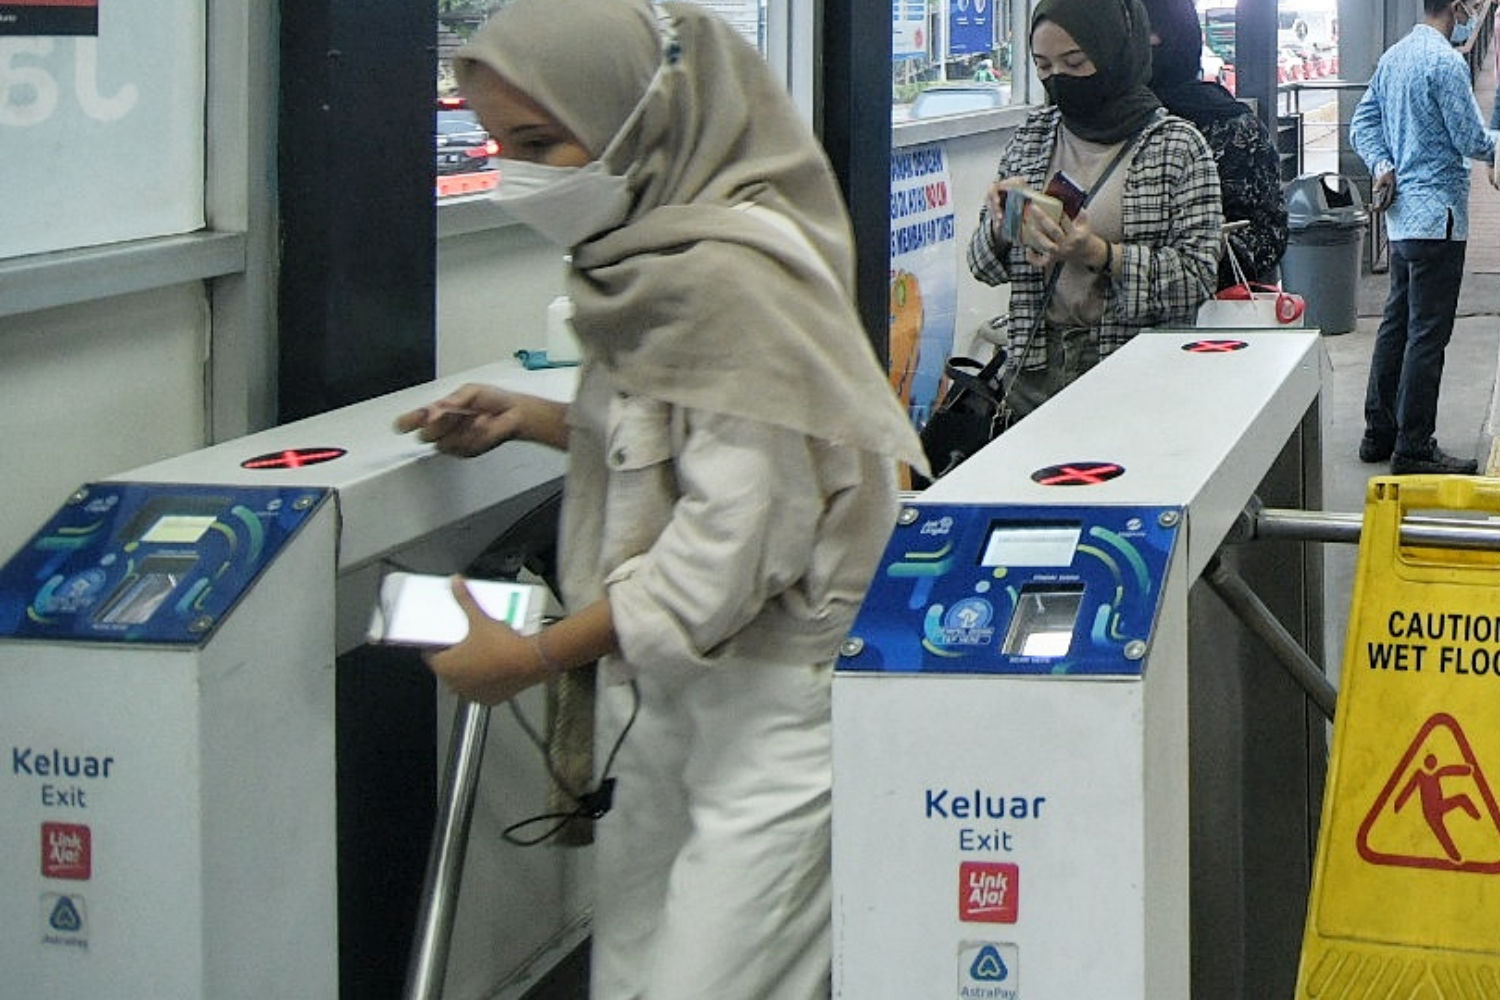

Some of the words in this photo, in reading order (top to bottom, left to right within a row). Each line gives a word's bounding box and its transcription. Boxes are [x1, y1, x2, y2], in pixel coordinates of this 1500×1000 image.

[1367, 642, 1428, 673] WET
[12, 747, 114, 779] Keluar
[41, 784, 87, 809] Exit
[925, 788, 1047, 820] Keluar
[959, 828, 1013, 852] Exit
[970, 871, 1008, 891] Link
[961, 986, 1016, 1000] AstraPay
